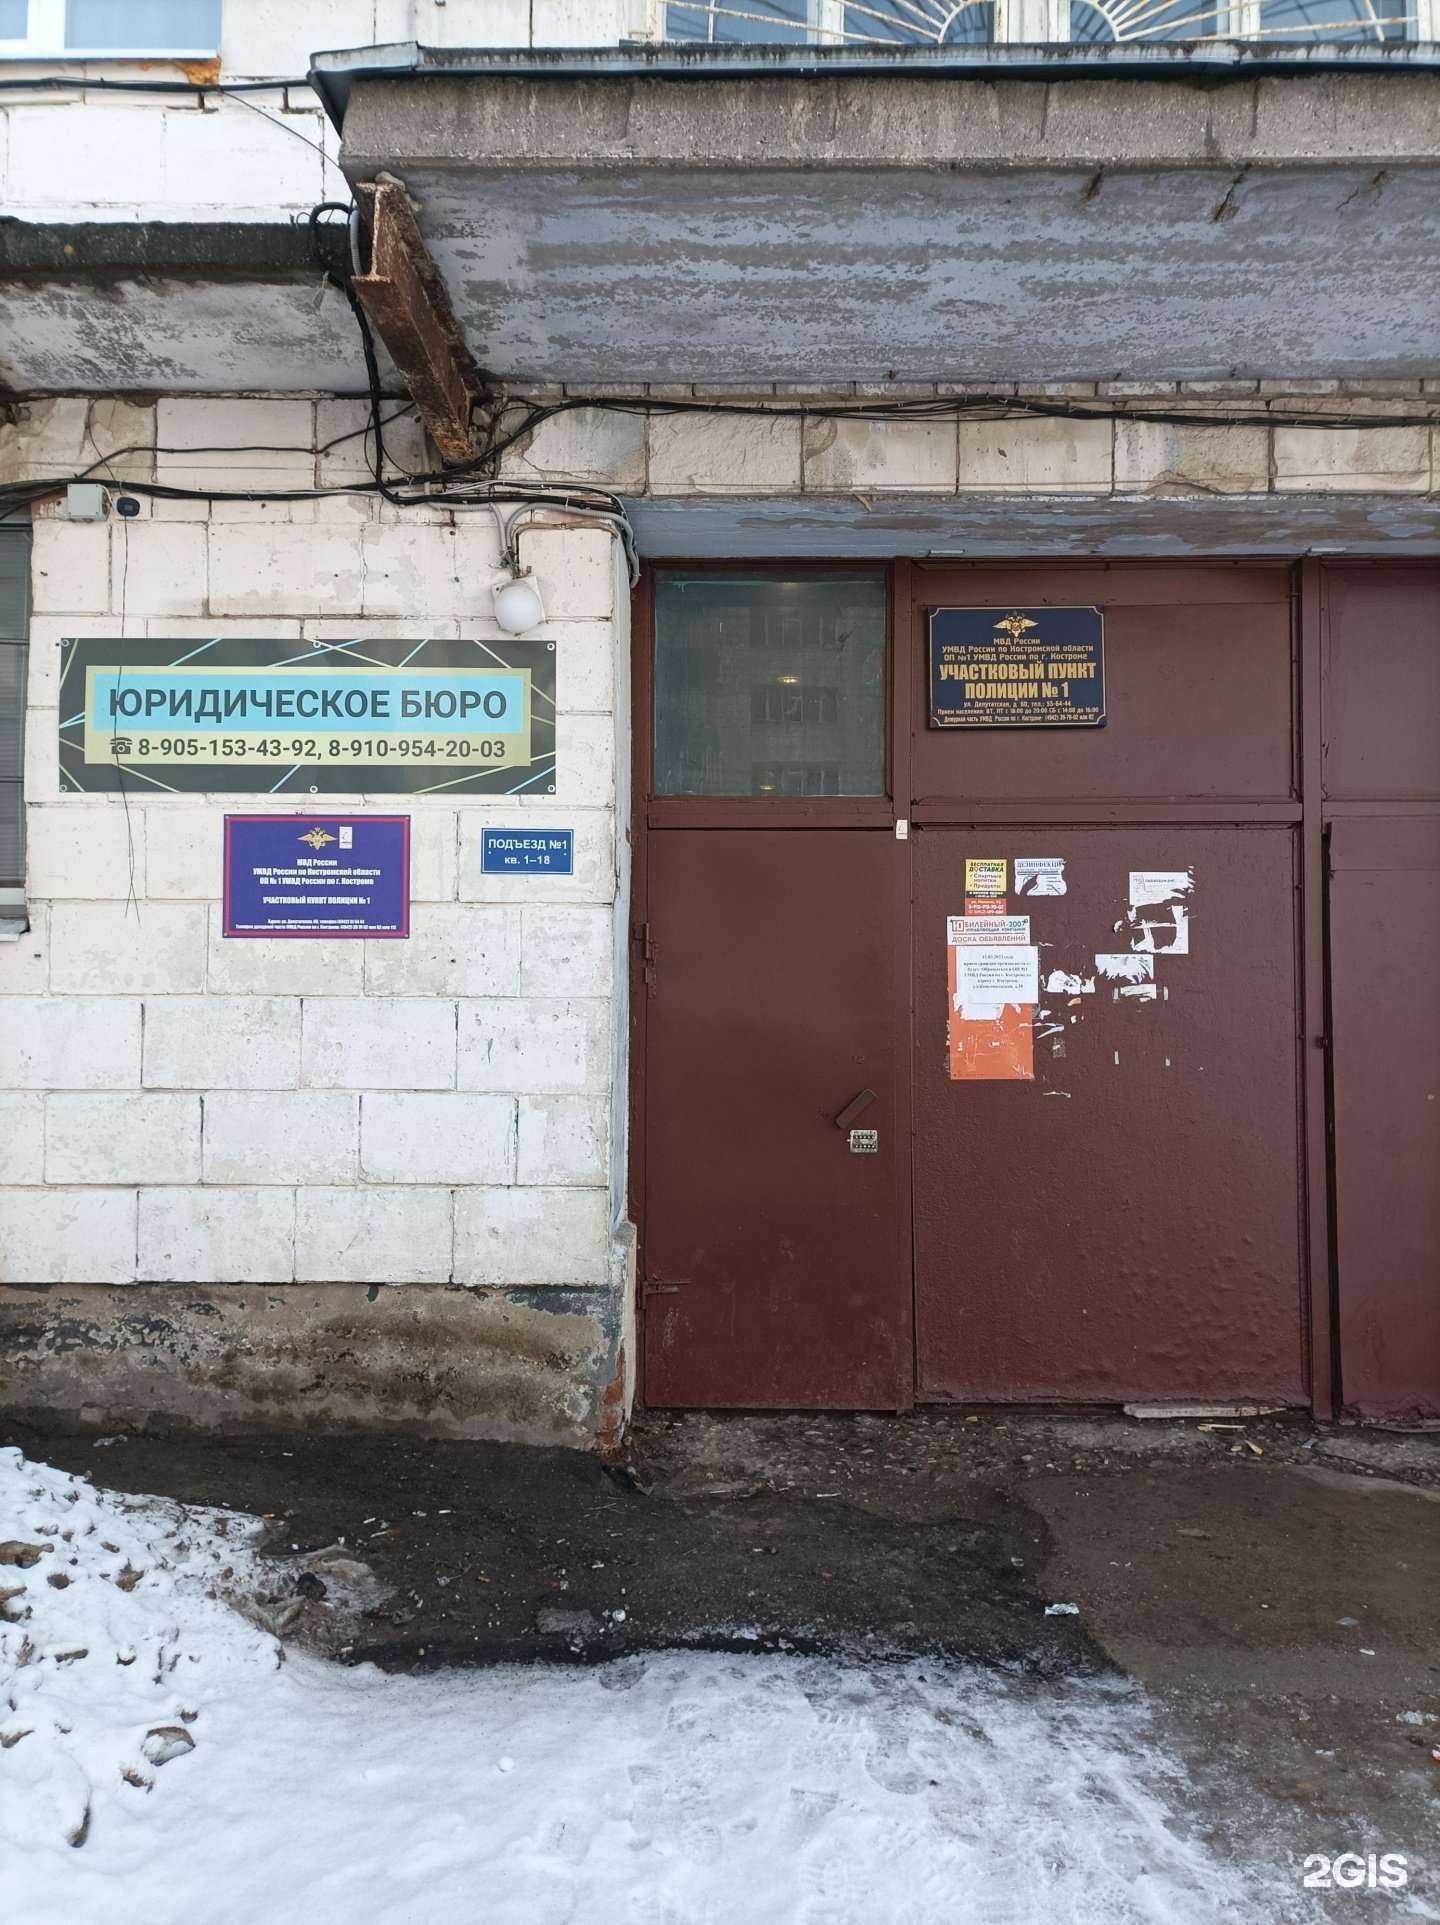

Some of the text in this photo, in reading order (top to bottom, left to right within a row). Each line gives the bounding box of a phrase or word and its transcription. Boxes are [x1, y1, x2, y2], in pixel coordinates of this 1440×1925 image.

[1014, 637, 1041, 645] России
[942, 646, 966, 654] УМВД
[1062, 644, 1094, 652] области
[973, 653, 997, 661] УМВД
[939, 661, 1097, 680] УЧАСТКОВЫЙ ПУНКТ
[965, 682, 1069, 701] ПОЛИЦИИ № 1
[108, 688, 508, 724] ЮРИДИЧЕСКОЕ БЮРО
[137, 736, 507, 760] 8-905-153-43-92, 8-910-954-20-03
[487, 838, 568, 851] ПОДЪЕЗД №1
[296, 858, 338, 867] МВД России
[504, 856, 521, 865] кв.
[272, 867, 298, 876] России
[301, 877, 326, 886] России
[978, 934, 1027, 943] ОБЪЯВЛЕНИЙ
